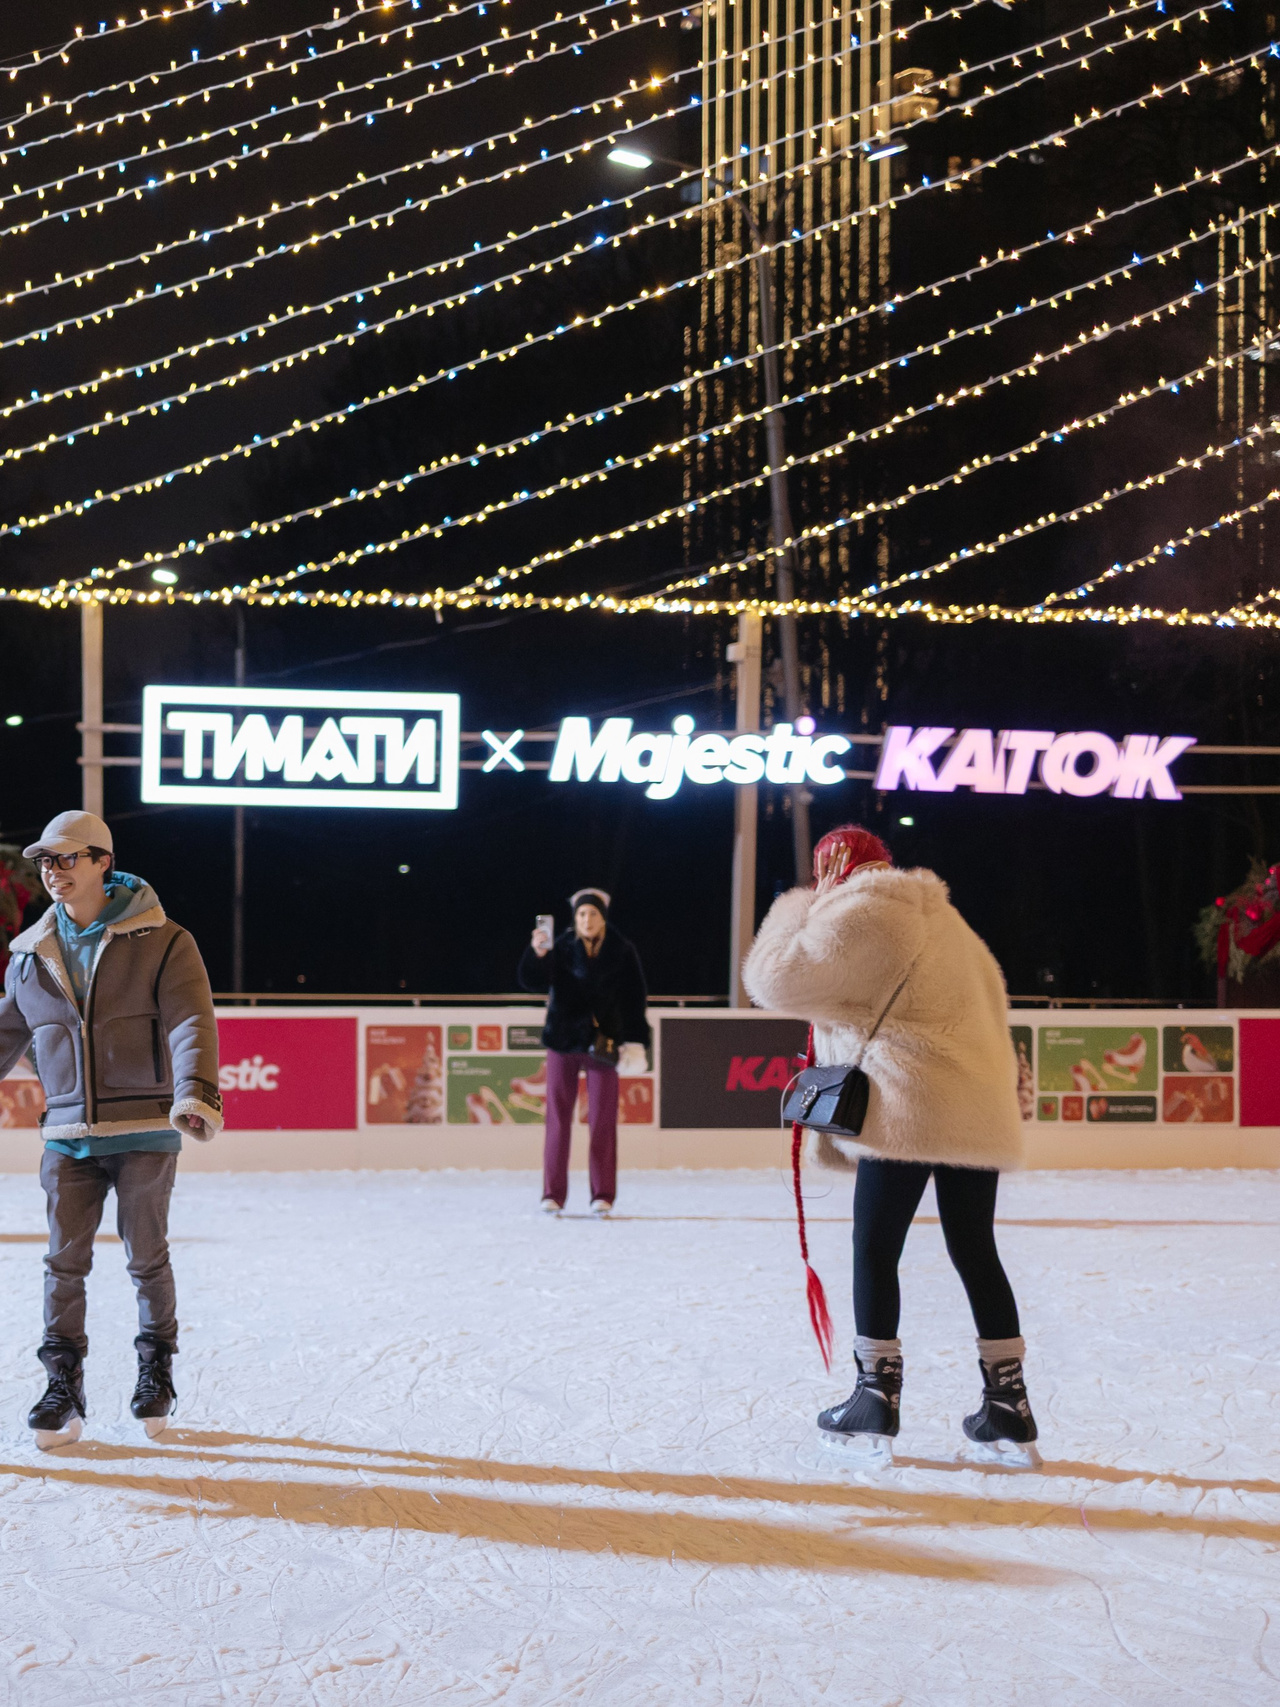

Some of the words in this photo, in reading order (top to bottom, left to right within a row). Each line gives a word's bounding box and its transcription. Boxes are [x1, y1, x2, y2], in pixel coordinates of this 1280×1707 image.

[166, 711, 437, 784] ТИМАТИ
[548, 714, 852, 800] Majestic
[874, 725, 1197, 800] КАТОК
[219, 1055, 280, 1091] stic
